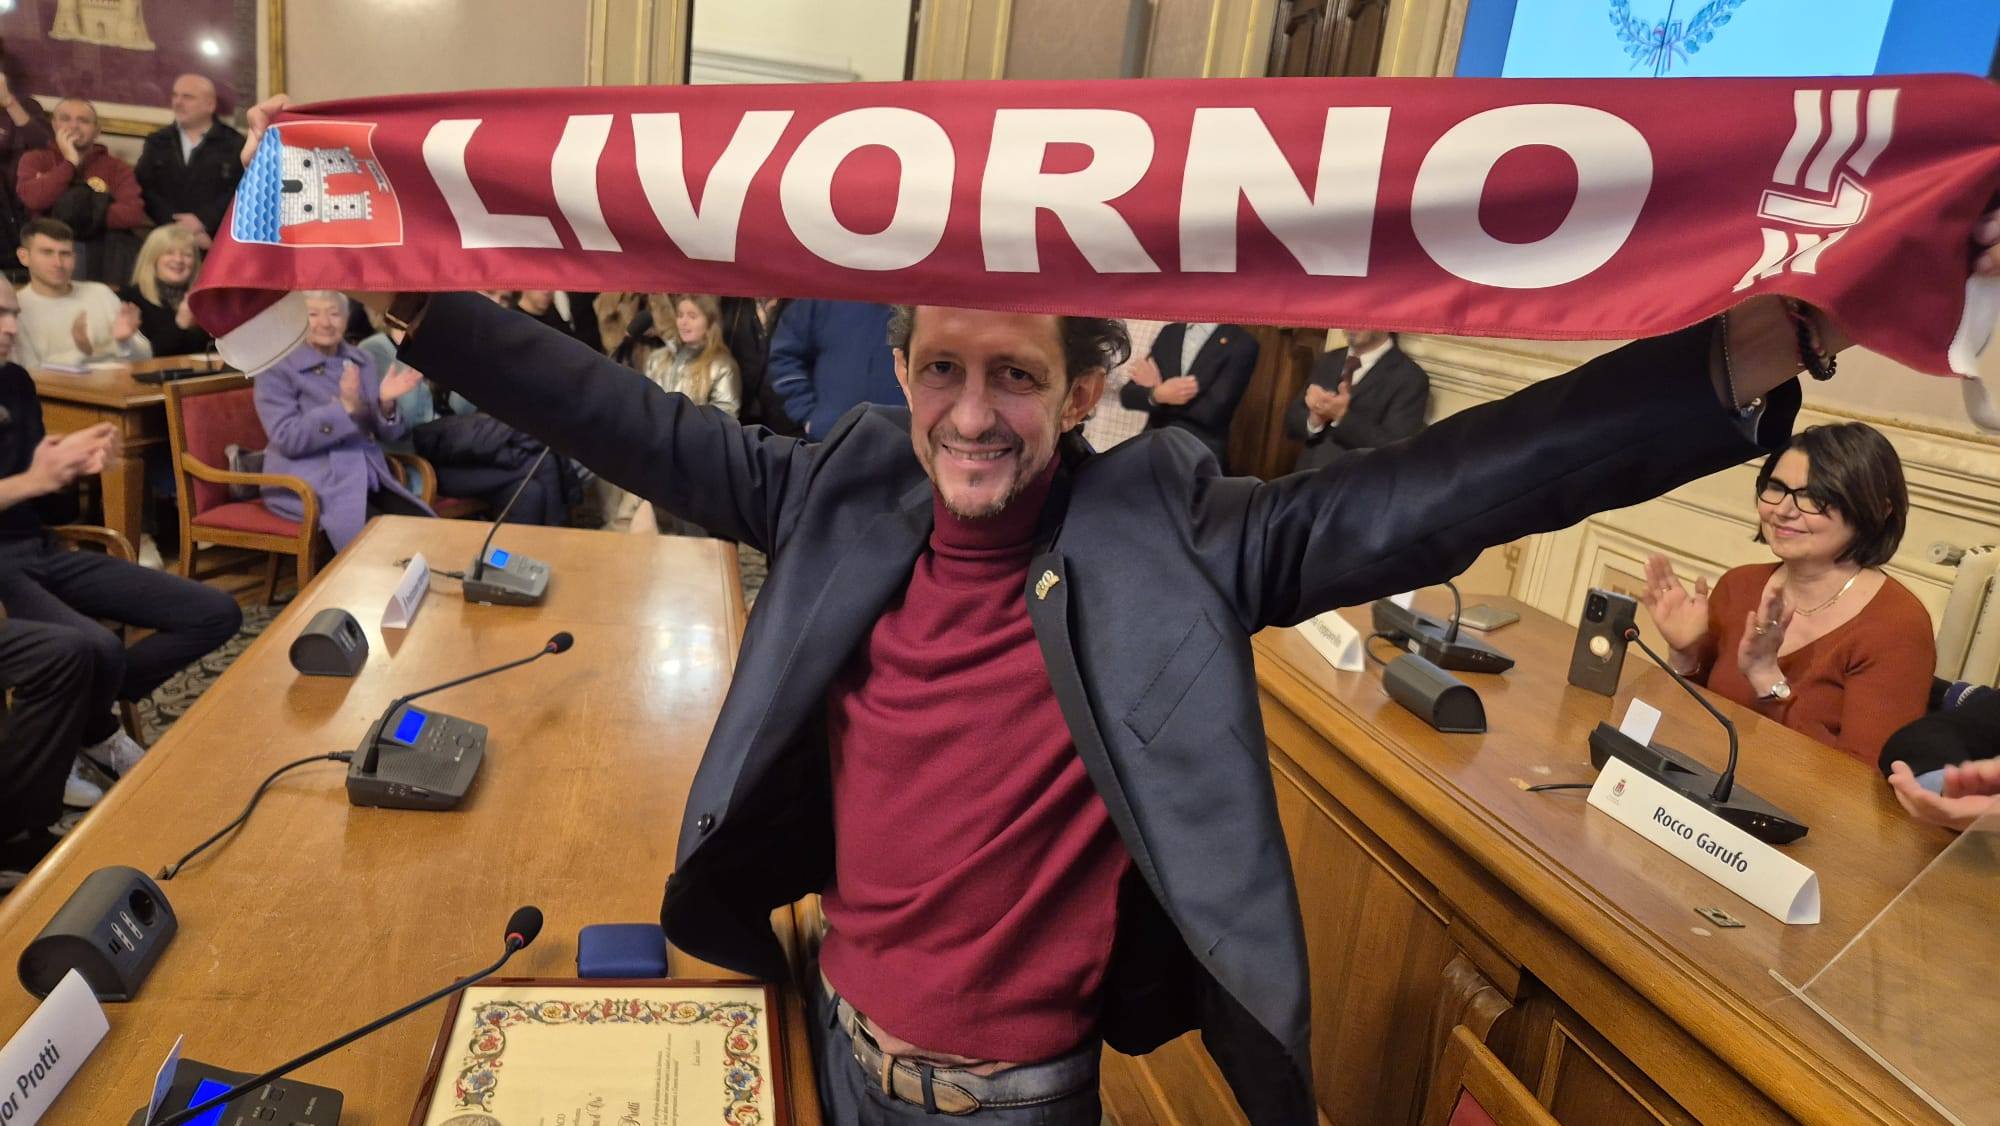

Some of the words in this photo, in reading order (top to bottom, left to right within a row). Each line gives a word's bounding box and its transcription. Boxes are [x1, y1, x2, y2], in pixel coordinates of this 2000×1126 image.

[421, 102, 1655, 291] LIVORNO
[1652, 806, 1694, 841] Rocco
[1695, 832, 1749, 874] Garufo
[0, 1091, 19, 1126] or
[16, 1038, 61, 1099] Protti
